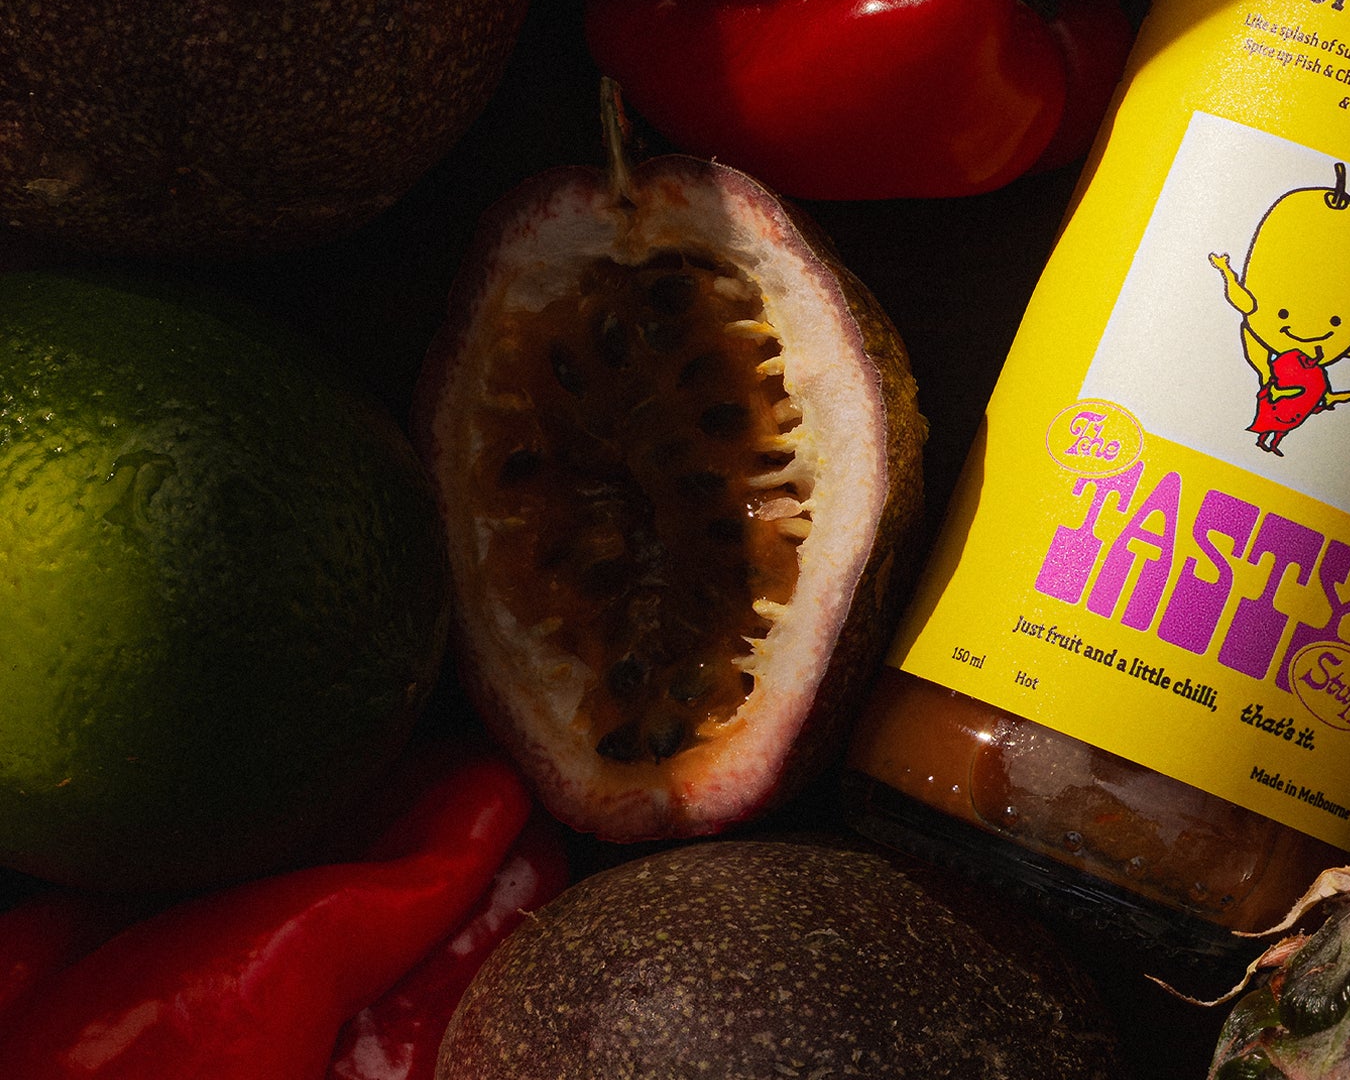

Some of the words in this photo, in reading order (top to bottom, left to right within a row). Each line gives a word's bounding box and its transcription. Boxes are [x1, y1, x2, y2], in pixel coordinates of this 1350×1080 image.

[1244, 13, 1267, 31] Like
[1270, 22, 1277, 33] a
[1280, 26, 1319, 48] splash
[1321, 39, 1338, 52] of
[1244, 38, 1275, 58] Spice
[1277, 49, 1293, 66] up
[1295, 54, 1321, 74] Fish
[1323, 64, 1334, 78] &
[1339, 97, 1350, 110] &
[1064, 411, 1120, 461] The
[951, 646, 970, 663] 150
[969, 654, 987, 670] ml
[1014, 671, 1040, 690] Hot
[1045, 625, 1083, 655] fruit
[1083, 644, 1117, 667] and
[1116, 657, 1127, 672] a
[1128, 657, 1171, 689] little
[1172, 679, 1219, 712] chilli,
[1240, 703, 1296, 741] that's
[1295, 727, 1315, 751] it.
[1250, 766, 1284, 791] Made
[1285, 779, 1298, 797] in
